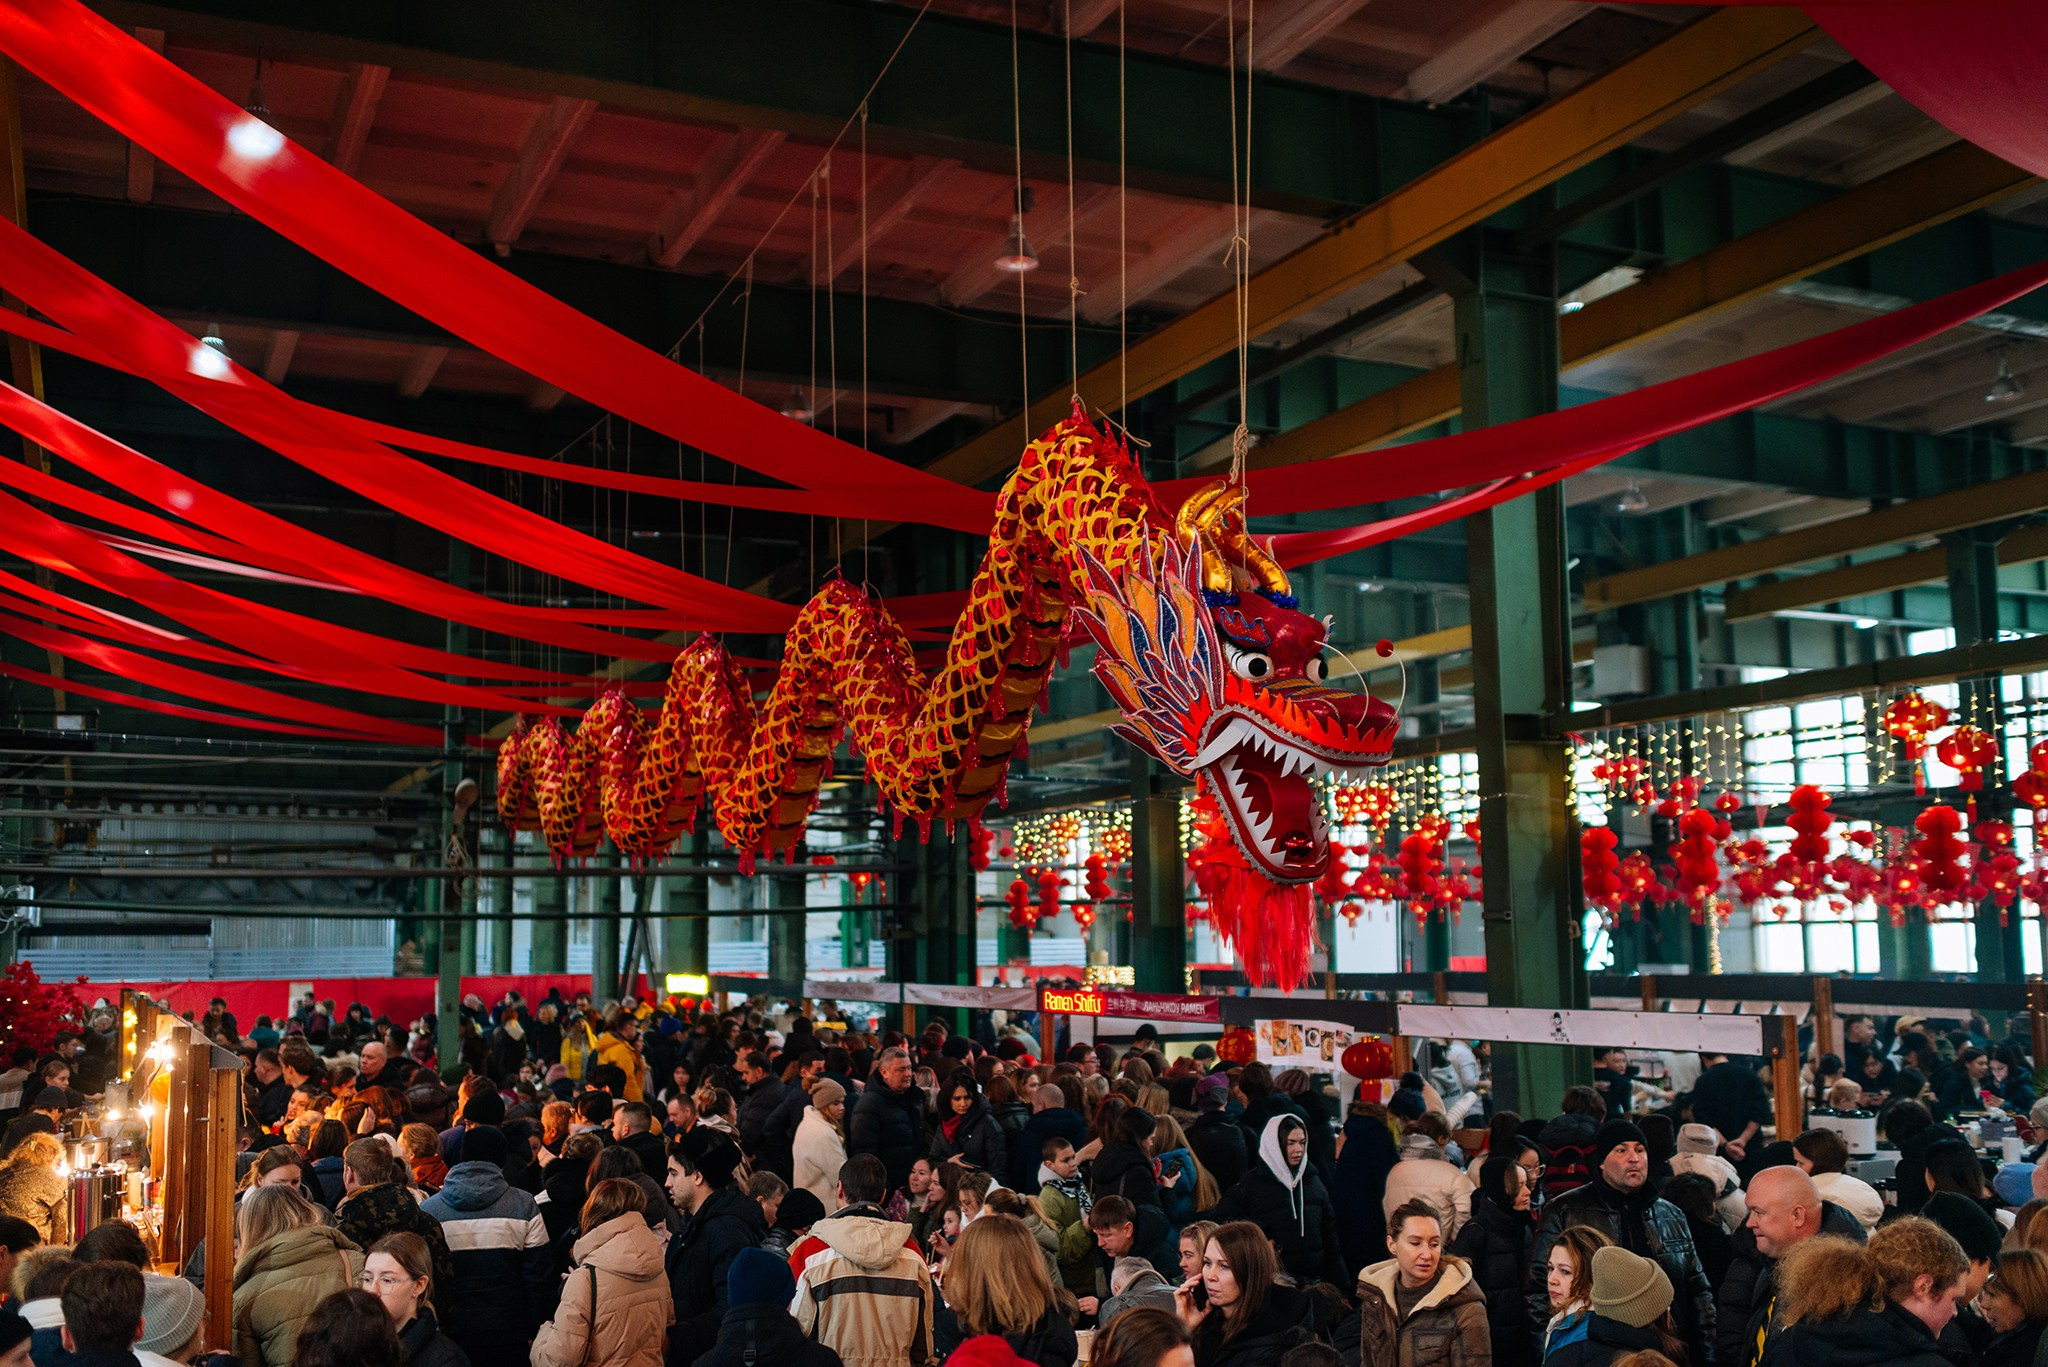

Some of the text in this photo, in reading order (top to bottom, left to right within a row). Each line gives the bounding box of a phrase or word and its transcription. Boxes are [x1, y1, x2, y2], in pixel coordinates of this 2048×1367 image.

[1044, 991, 1101, 1013] Ramen Shifu
[1181, 1002, 1206, 1015] РАМЕН
